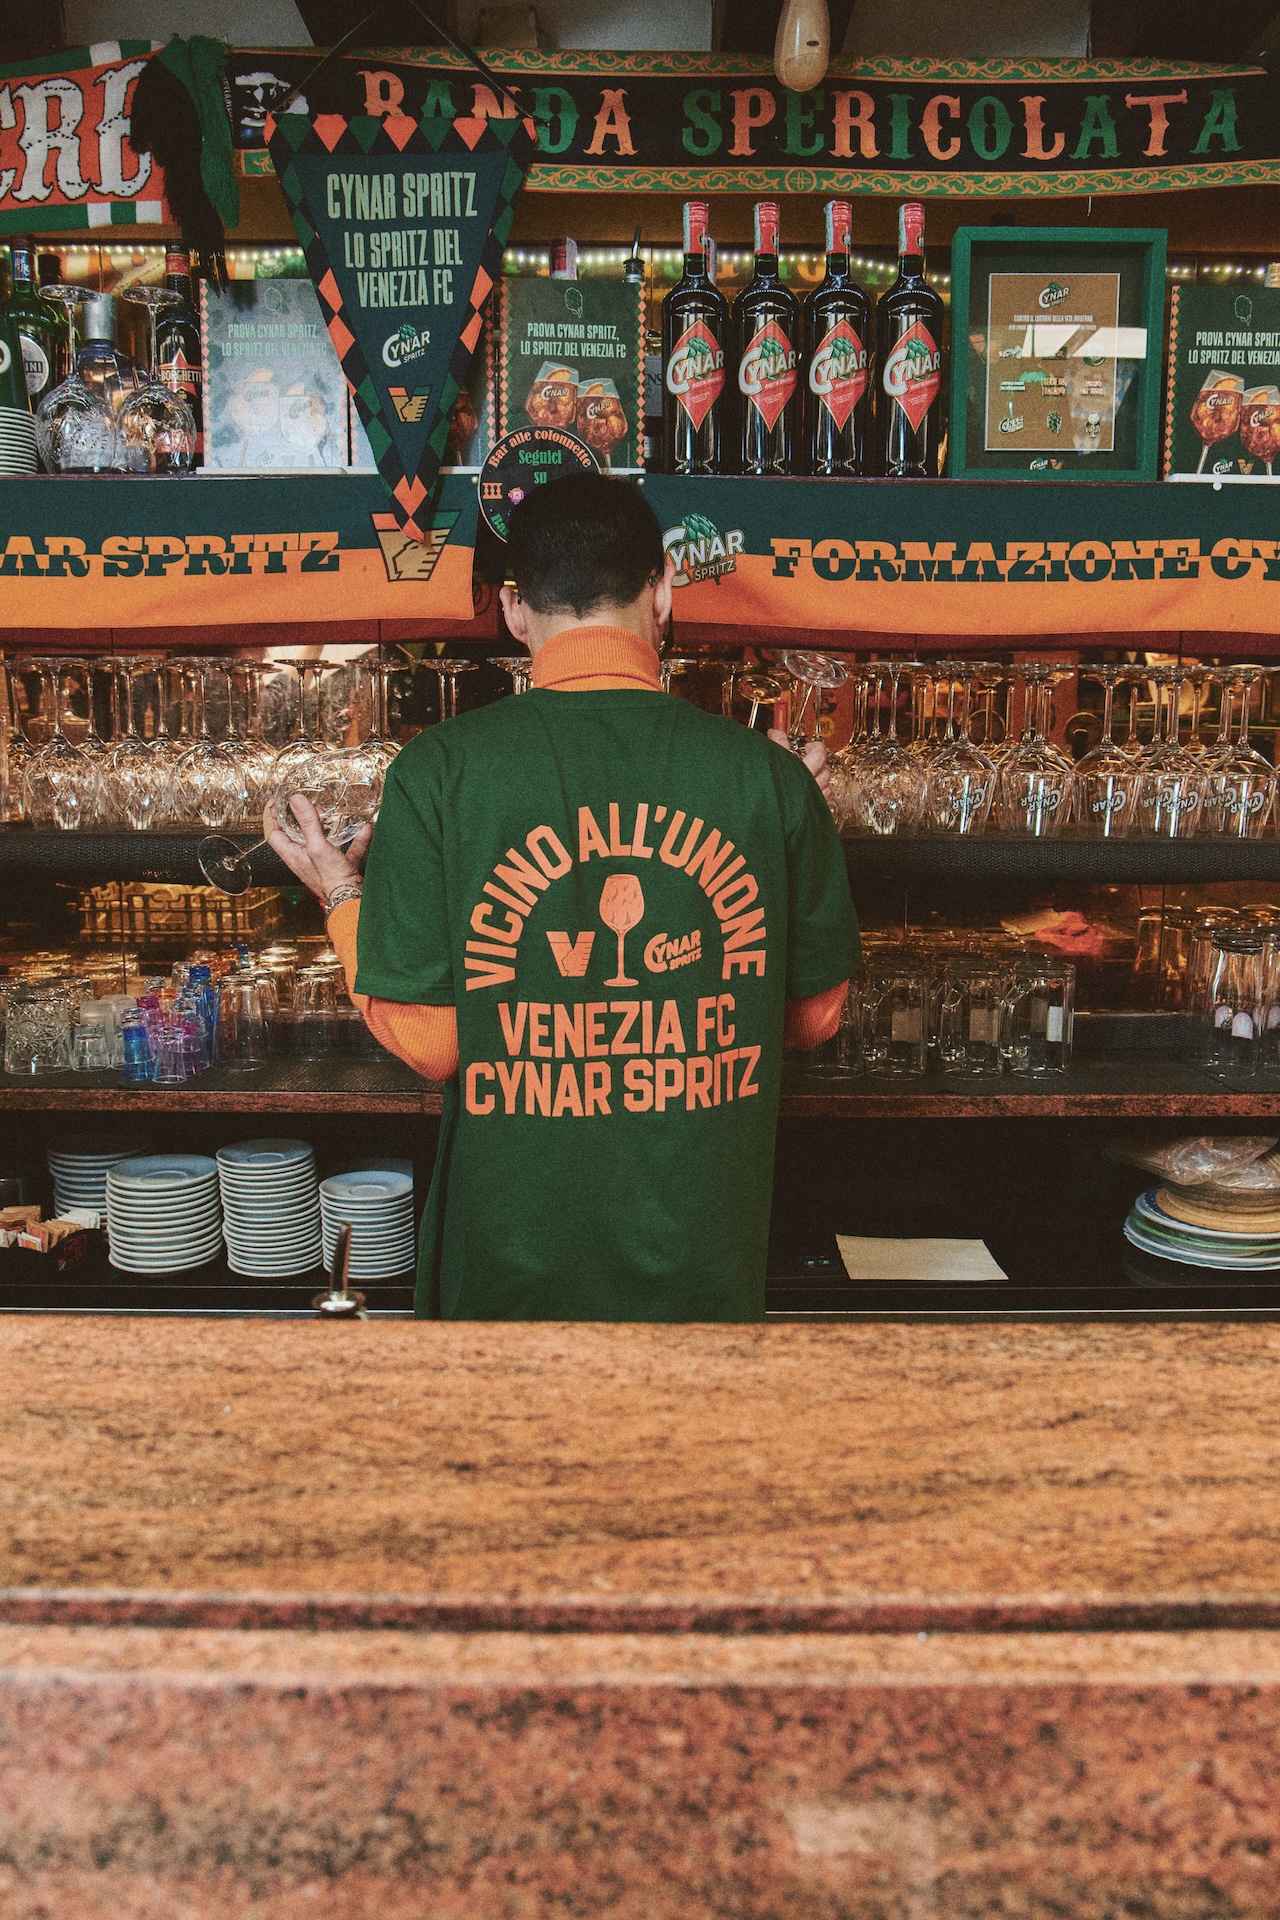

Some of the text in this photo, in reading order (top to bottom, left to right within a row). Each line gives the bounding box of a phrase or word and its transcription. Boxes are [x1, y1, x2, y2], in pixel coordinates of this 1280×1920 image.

[682, 87, 1245, 160] SPERICOLATA
[326, 171, 478, 220] CYNAR SPRITZ
[344, 229, 463, 269] LO SPRITZ DEL
[356, 268, 454, 308] VENEZIA FC
[1038, 287, 1069, 308] CYNAR
[221, 342, 231, 356] LO
[234, 342, 263, 356] SPRITZ
[228, 323, 257, 338] PROVA
[257, 323, 286, 338] CYNAR
[382, 330, 431, 368] CYNAR
[520, 340, 627, 358] LO SPRITZ DEL VENEZIA FC
[527, 322, 556, 338] PROVA
[557, 323, 585, 339] CYNAR
[1195, 331, 1224, 346] PROVA
[1225, 332, 1252, 347] CYNAR
[403, 348, 426, 364] SPRITZ
[666, 346, 724, 396] CYNAR
[738, 346, 797, 397] CYNAR
[809, 346, 867, 396] CYNAR
[882, 347, 941, 397] CYNAR
[1188, 349, 1280, 365] LO SPRITZ DEL VENEZIA
[541, 385, 568, 400] CYNAR
[586, 399, 611, 419] CYNAR
[1206, 394, 1232, 409] CYNAR
[1250, 408, 1274, 427] CYNAR
[487, 429, 592, 468] Bar alle colonnette
[518, 449, 562, 467] Seguici
[533, 471, 548, 484] su
[101, 531, 340, 577] SPRITZ
[662, 526, 746, 588] CYNAR
[694, 559, 735, 581] SPRITZ
[770, 536, 1200, 582] FORMAZIONE
[464, 802, 767, 991] VICINO ALL'UNIONE
[643, 929, 702, 973] CYNAR
[668, 947, 702, 971] SPRITZ
[497, 993, 736, 1058] VENEZIA FC
[465, 1045, 762, 1117] CYNAR SPRITZ
